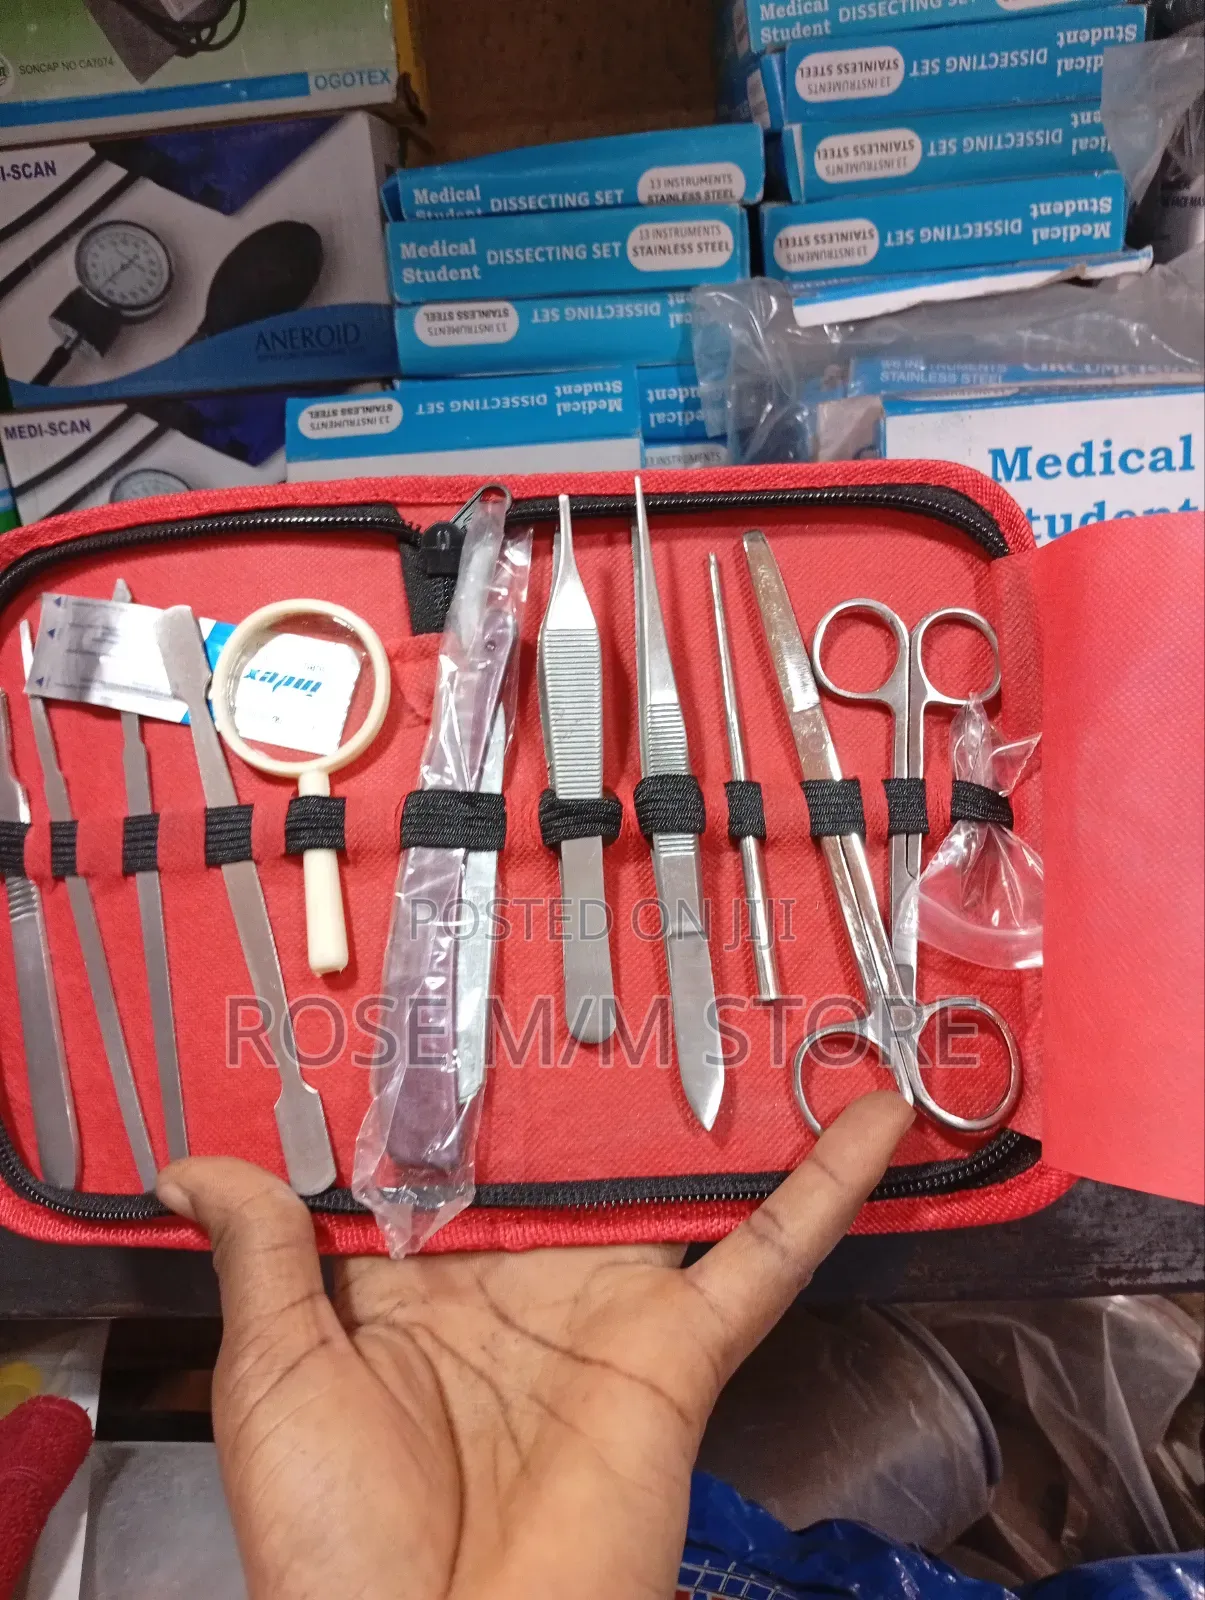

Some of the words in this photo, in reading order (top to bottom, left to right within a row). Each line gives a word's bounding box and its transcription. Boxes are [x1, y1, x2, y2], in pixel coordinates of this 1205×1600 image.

[760, 0, 829, 21] Medical
[838, 0, 942, 23] DISSECTING
[760, 18, 832, 45] Student
[1056, 23, 1138, 49] Student
[19, 61, 59, 75] SONCAP
[61, 60, 77, 71] NO
[836, 58, 900, 75] STAINLESS
[909, 58, 940, 77] SET
[945, 47, 1048, 73] DISSECTING
[314, 67, 391, 90] OGOTEX
[799, 64, 833, 79] STEEL
[807, 77, 879, 96] INSTRUMENTS
[880, 75, 892, 88] 13
[852, 139, 915, 156] STAINLESS
[927, 138, 957, 157] SET
[962, 127, 1063, 153] DISSECTING
[1072, 136, 1111, 156] ical
[817, 145, 850, 161] STEEL
[896, 156, 907, 169] 13
[825, 158, 895, 177] INSTRUMENTS
[650, 177, 660, 190] 13
[663, 172, 733, 189] INSTRUMENTS
[412, 184, 482, 205] Medical
[490, 192, 590, 213] DISSECTING
[594, 188, 625, 205] SET
[647, 191, 702, 204] STAINLESS
[704, 188, 735, 201] STEEL
[1029, 196, 1113, 220] Student
[639, 229, 650, 241] 13
[652, 224, 722, 240] INSTRUMENTS
[813, 227, 875, 245] STAINLESS
[884, 229, 915, 247] SET
[919, 217, 1023, 245] DISSECTING
[1032, 221, 1112, 246] Medical
[400, 236, 477, 260] Medical
[632, 242, 694, 258] STAINLESS
[696, 239, 732, 254] STEEL
[778, 234, 811, 249] STEEL
[857, 245, 868, 257] 13
[486, 245, 588, 266] DISSECTING
[592, 241, 622, 259] SET
[786, 246, 856, 265] INSTRUMENTS
[402, 264, 482, 285] Student
[423, 311, 455, 323] STEEL
[457, 307, 510, 321] STAINLESS
[531, 306, 561, 324] SET
[565, 301, 662, 322] DISSECTING
[255, 321, 361, 351] ANEROID
[427, 322, 494, 337] INSTRUMENTS
[496, 321, 508, 333] 13
[880, 370, 957, 385] STAINLESS
[555, 380, 623, 398] Student
[341, 403, 394, 416] STAINLESS
[415, 401, 445, 416] SET
[449, 393, 548, 413] DISSECTING
[556, 398, 623, 417] Medical
[308, 408, 339, 420] STEEL
[310, 416, 377, 431] INSTRUMENTS
[380, 414, 390, 426] 13
[649, 409, 705, 429] edical
[4, 418, 92, 440] MEDI-SCAN
[988, 433, 1195, 483] Medical
